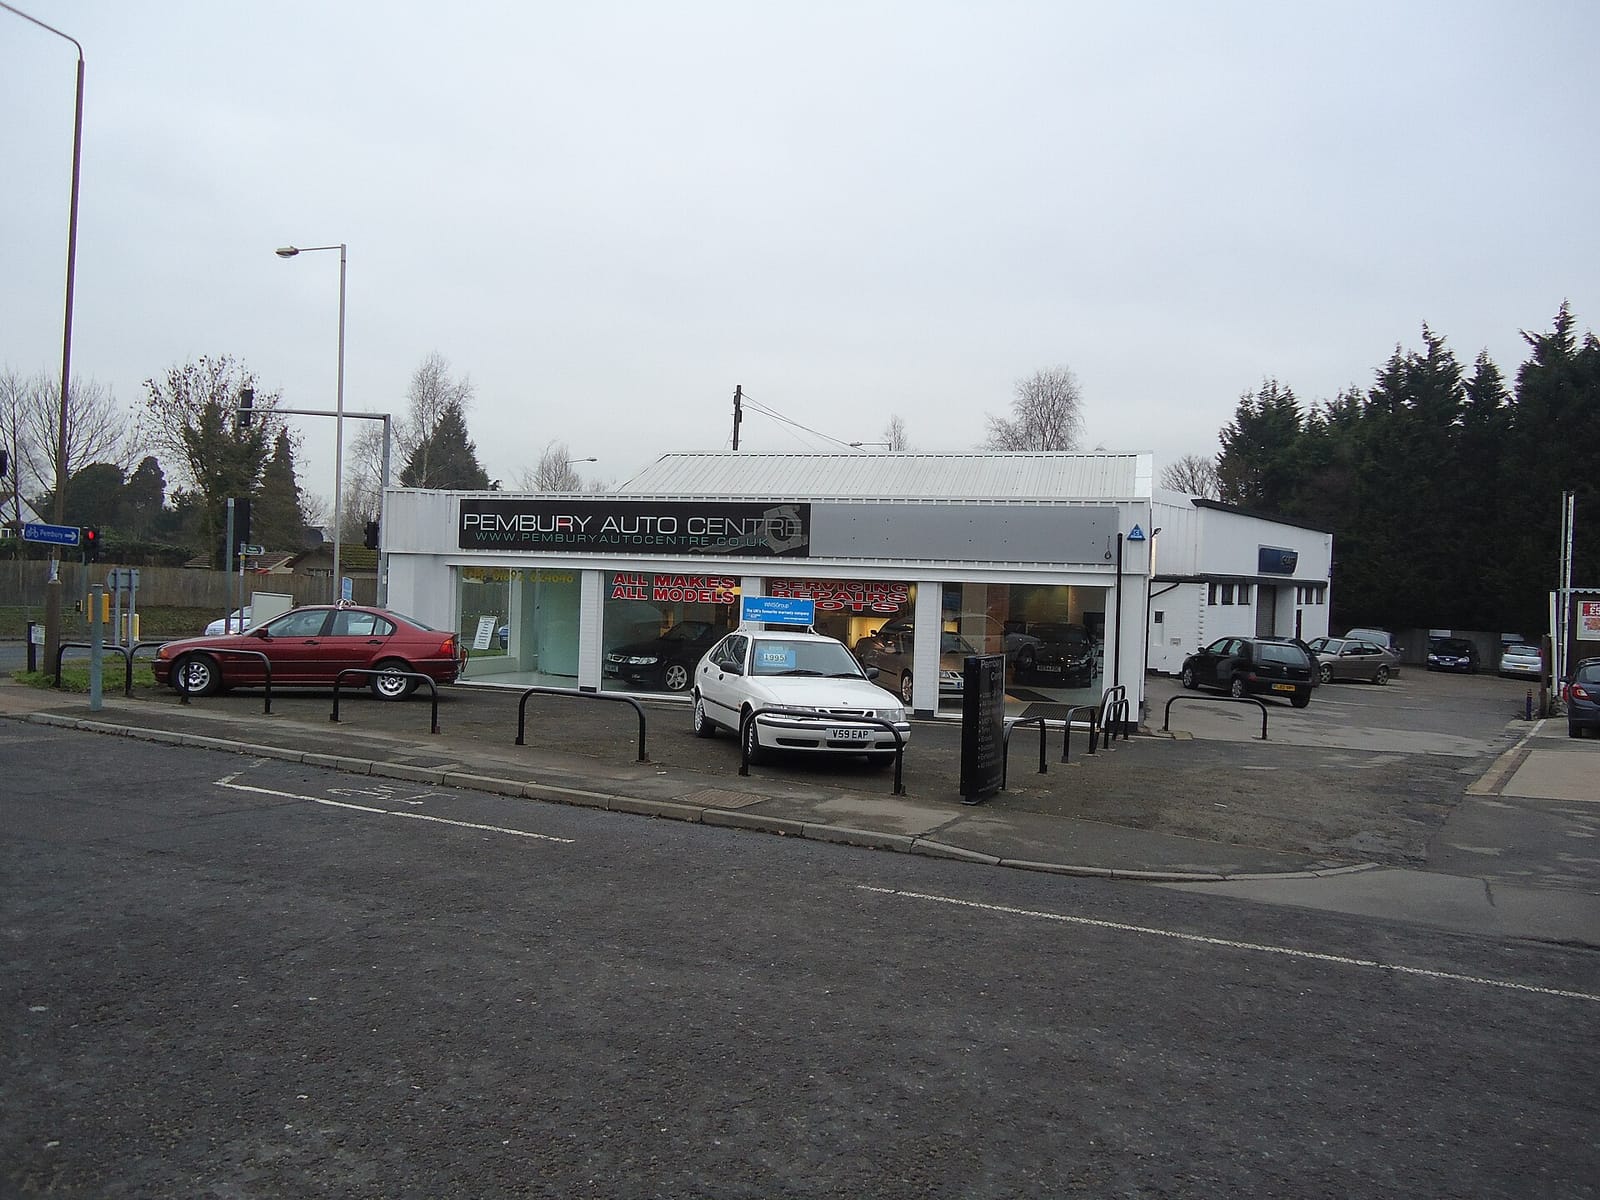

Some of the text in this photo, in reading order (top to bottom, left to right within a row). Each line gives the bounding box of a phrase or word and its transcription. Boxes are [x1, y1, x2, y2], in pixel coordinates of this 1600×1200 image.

[463, 513, 803, 537] PEMBURY AUTO CENTRE
[475, 531, 769, 548] WWW.PEMBURYAUTOCENTRE.CO.UK
[612, 573, 736, 590] ALL MAKES
[772, 580, 909, 593] SERVICING
[611, 586, 735, 604] ALL MODELS
[771, 589, 908, 603] REPAIRS
[814, 600, 900, 613] OTS
[832, 729, 869, 740] V59 EAP
